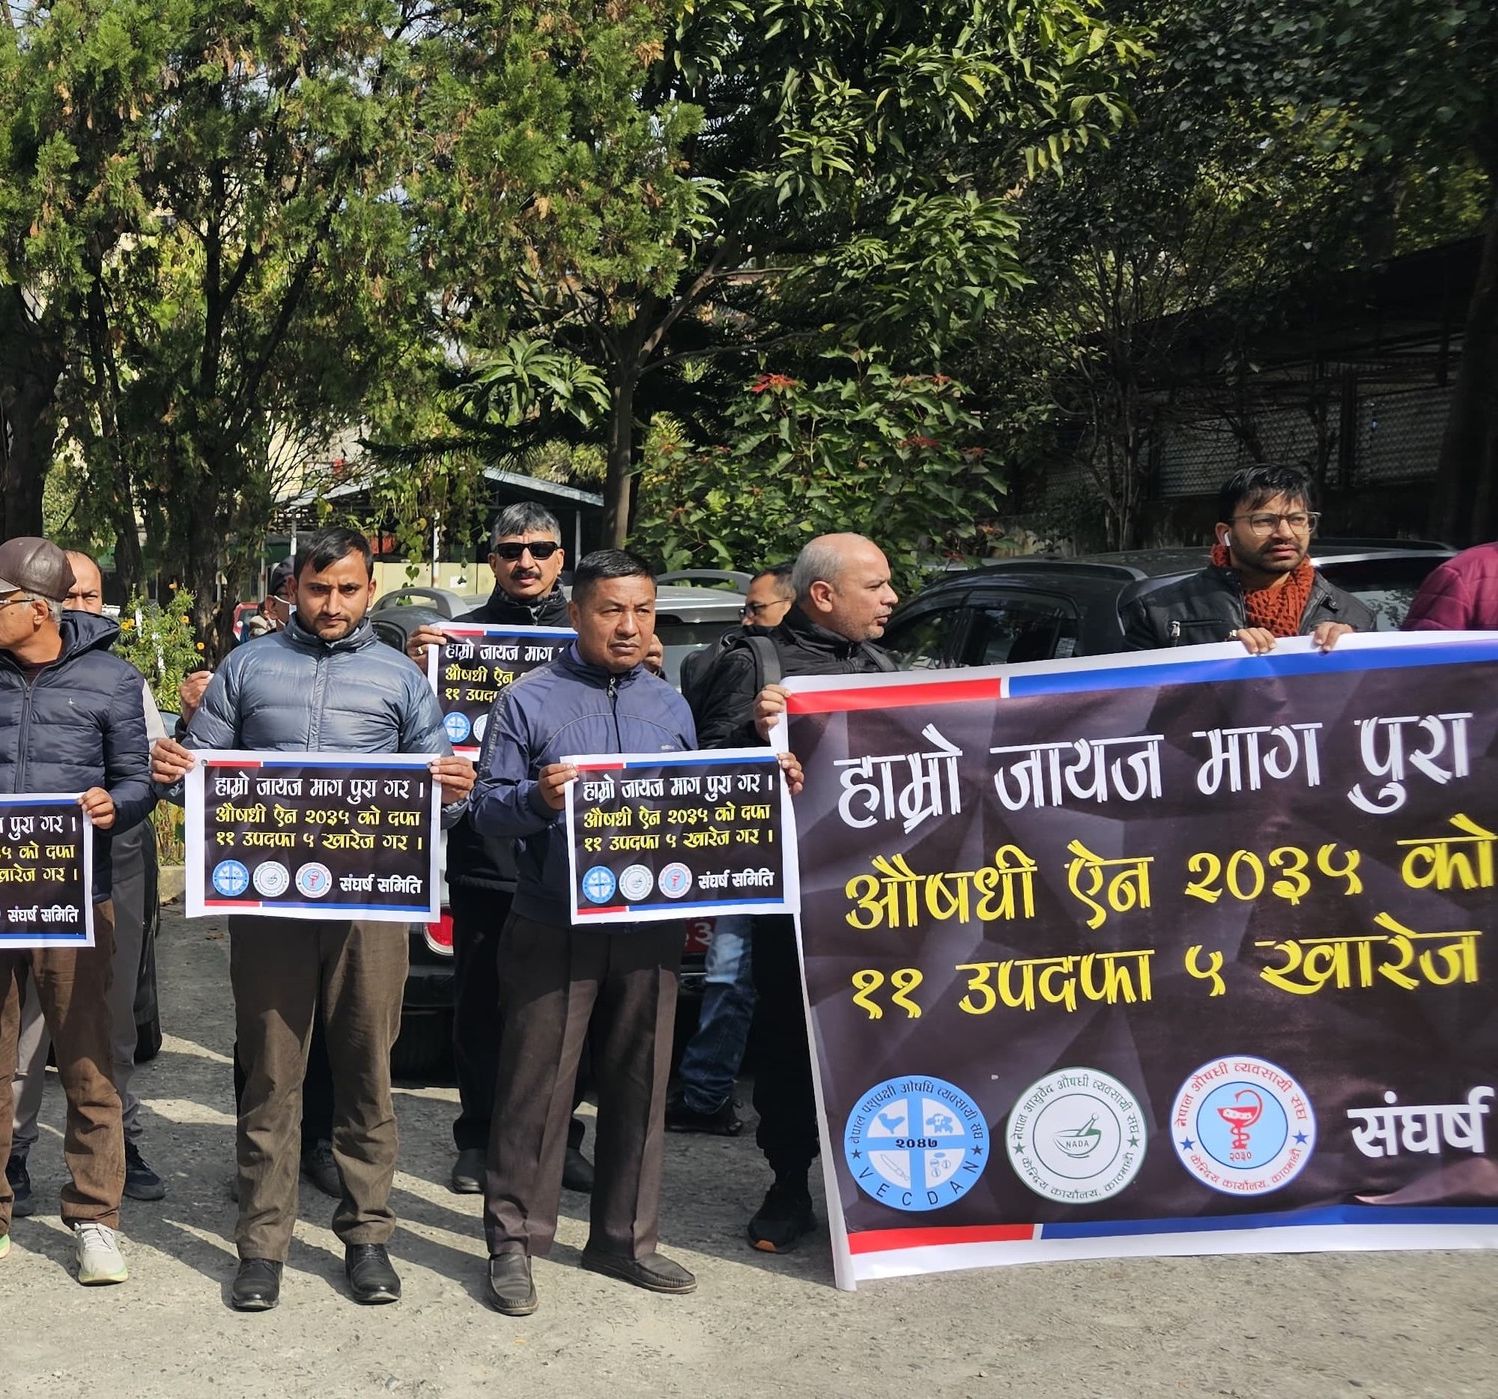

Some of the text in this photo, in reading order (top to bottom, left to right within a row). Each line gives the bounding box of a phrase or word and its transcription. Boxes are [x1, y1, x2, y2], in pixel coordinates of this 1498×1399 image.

[466, 689, 498, 702] उपद
[834, 713, 1473, 834] हाम्रो जायज माग पुरा
[214, 771, 249, 798] हाम्रो
[256, 778, 303, 795] जायज
[310, 779, 343, 796] माग
[347, 780, 377, 804] पुरा
[583, 774, 614, 803] हाम्रो
[620, 779, 664, 798] जायज
[670, 777, 701, 795] माग
[705, 775, 732, 801] पुरा
[216, 803, 421, 827] औषधी ऐन २०३५ को दफा
[584, 801, 770, 829] औषधी ऐन २०३५ को दफा
[8, 817, 34, 840] पुरा
[217, 832, 235, 846] ११
[242, 832, 296, 847] उपदफा
[303, 833, 313, 847] ५
[322, 829, 375, 849] खारेज
[585, 837, 602, 851] ११
[609, 835, 660, 850] उपदफा
[666, 834, 676, 847] ५
[683, 826, 730, 848] खारेज
[19, 841, 39, 859] को
[45, 845, 75, 859] दफा
[698, 870, 730, 889] संघर्ष
[732, 868, 774, 887] समिति
[846, 813, 1498, 929] औषधी ऐन २०३५ को
[339, 874, 375, 891] संघर्ष
[377, 875, 422, 894] समिति
[7, 905, 38, 922] संघर्ष
[40, 905, 79, 922] समिति
[852, 912, 1482, 1019] ११ उपदफा ५ खारेज
[1347, 1085, 1495, 1158] संघर्ष
